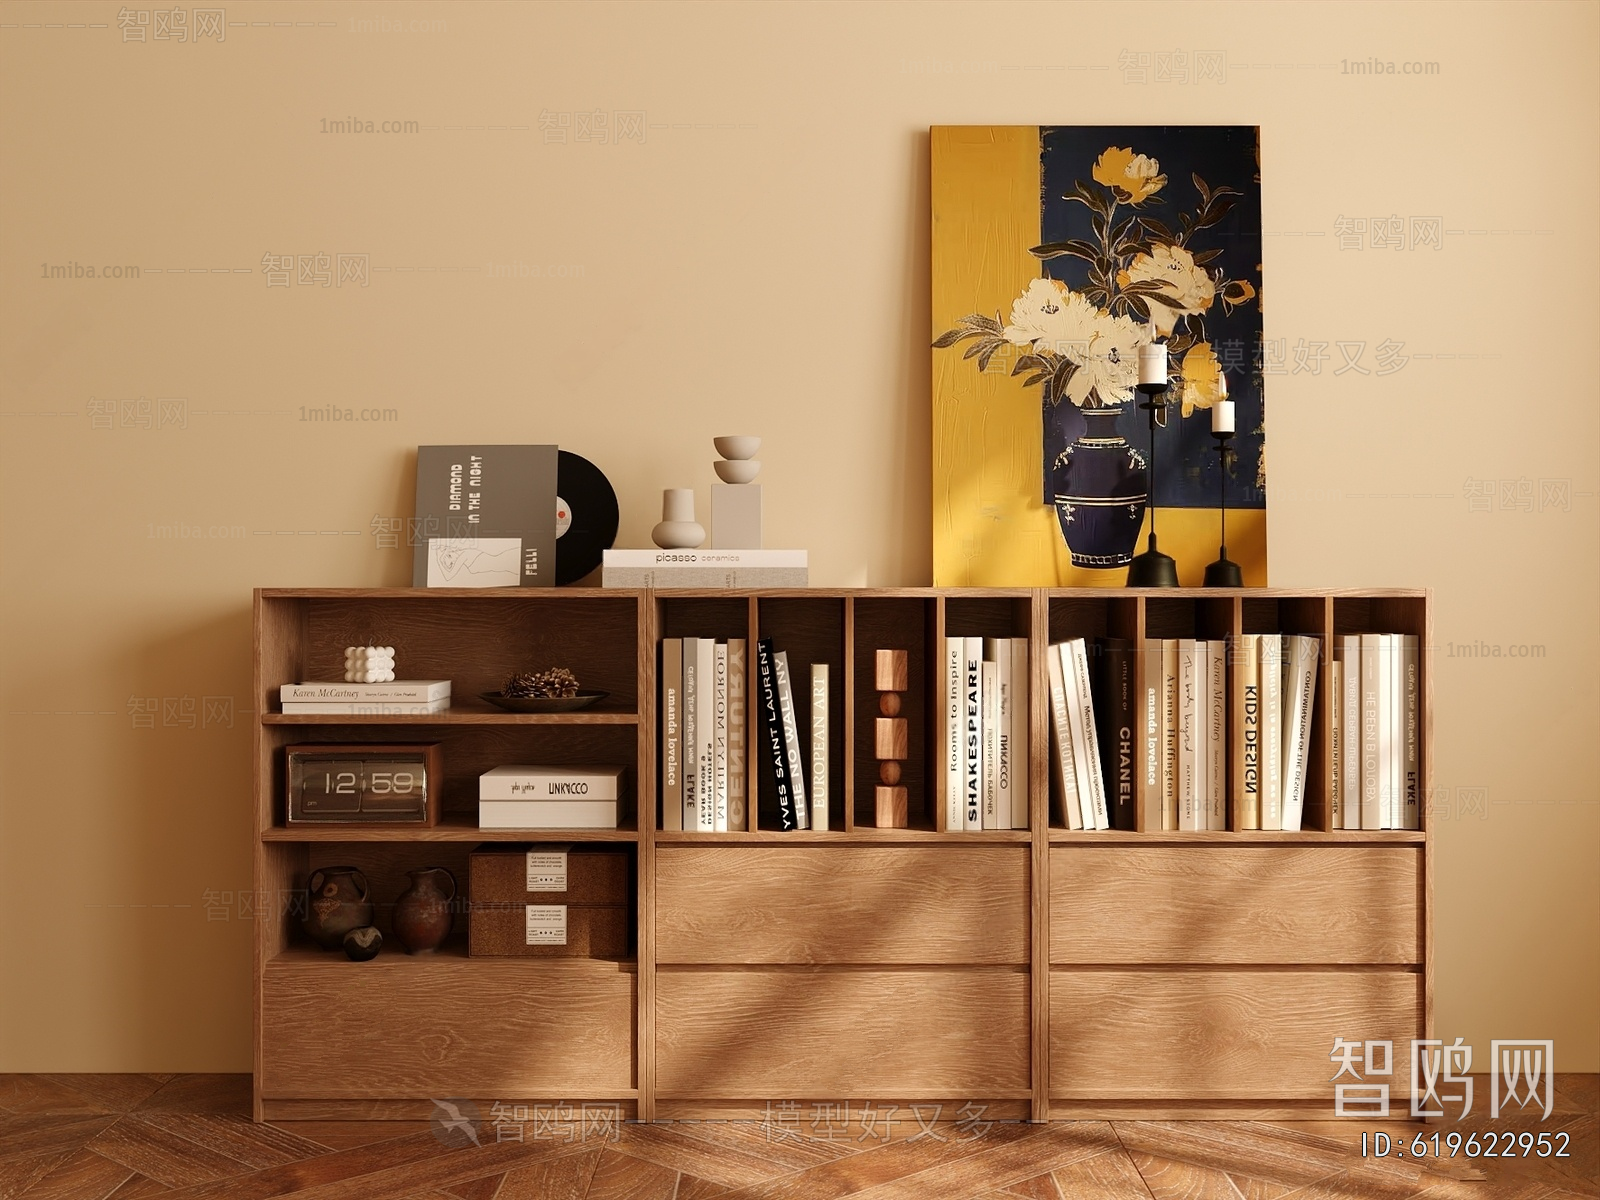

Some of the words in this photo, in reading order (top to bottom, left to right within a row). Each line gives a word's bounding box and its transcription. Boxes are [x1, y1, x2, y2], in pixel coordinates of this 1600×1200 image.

[450, 464, 463, 511] DIAMOND
[470, 455, 482, 487] NIGHT
[469, 492, 481, 511] THE
[469, 511, 480, 524] IN
[526, 548, 537, 576] FELLI
[656, 552, 697, 564] picasso
[758, 642, 776, 721] LAURENT
[775, 658, 786, 685] NY
[950, 651, 959, 699] Inspire
[1184, 655, 1193, 679] The
[1213, 657, 1223, 685] Karen
[293, 689, 316, 698] Karen
[318, 689, 359, 699] McCartney
[667, 688, 677, 734] amanda
[813, 676, 824, 710] ART
[951, 704, 958, 719] to
[1054, 686, 1068, 740] СПАСИТЕ
[1148, 688, 1157, 734] amanda
[1166, 674, 1175, 723] Arianna
[1211, 689, 1222, 742] McCartney
[780, 690, 794, 743] WALL
[1083, 705, 1093, 729] Метод
[667, 738, 677, 786] lovelace
[770, 727, 785, 778] SAINT
[788, 749, 800, 777] NO
[813, 716, 825, 808] EUROPEAN
[968, 660, 977, 822] SHAKESPEARE
[1000, 735, 1008, 789] ПИКАССО
[1148, 737, 1157, 785] lovelace
[1164, 729, 1176, 797] Huffington
[372, 773, 413, 794] 59
[1119, 726, 1131, 806] CHANEL
[778, 785, 791, 829] YVES
[791, 783, 805, 820] THE
